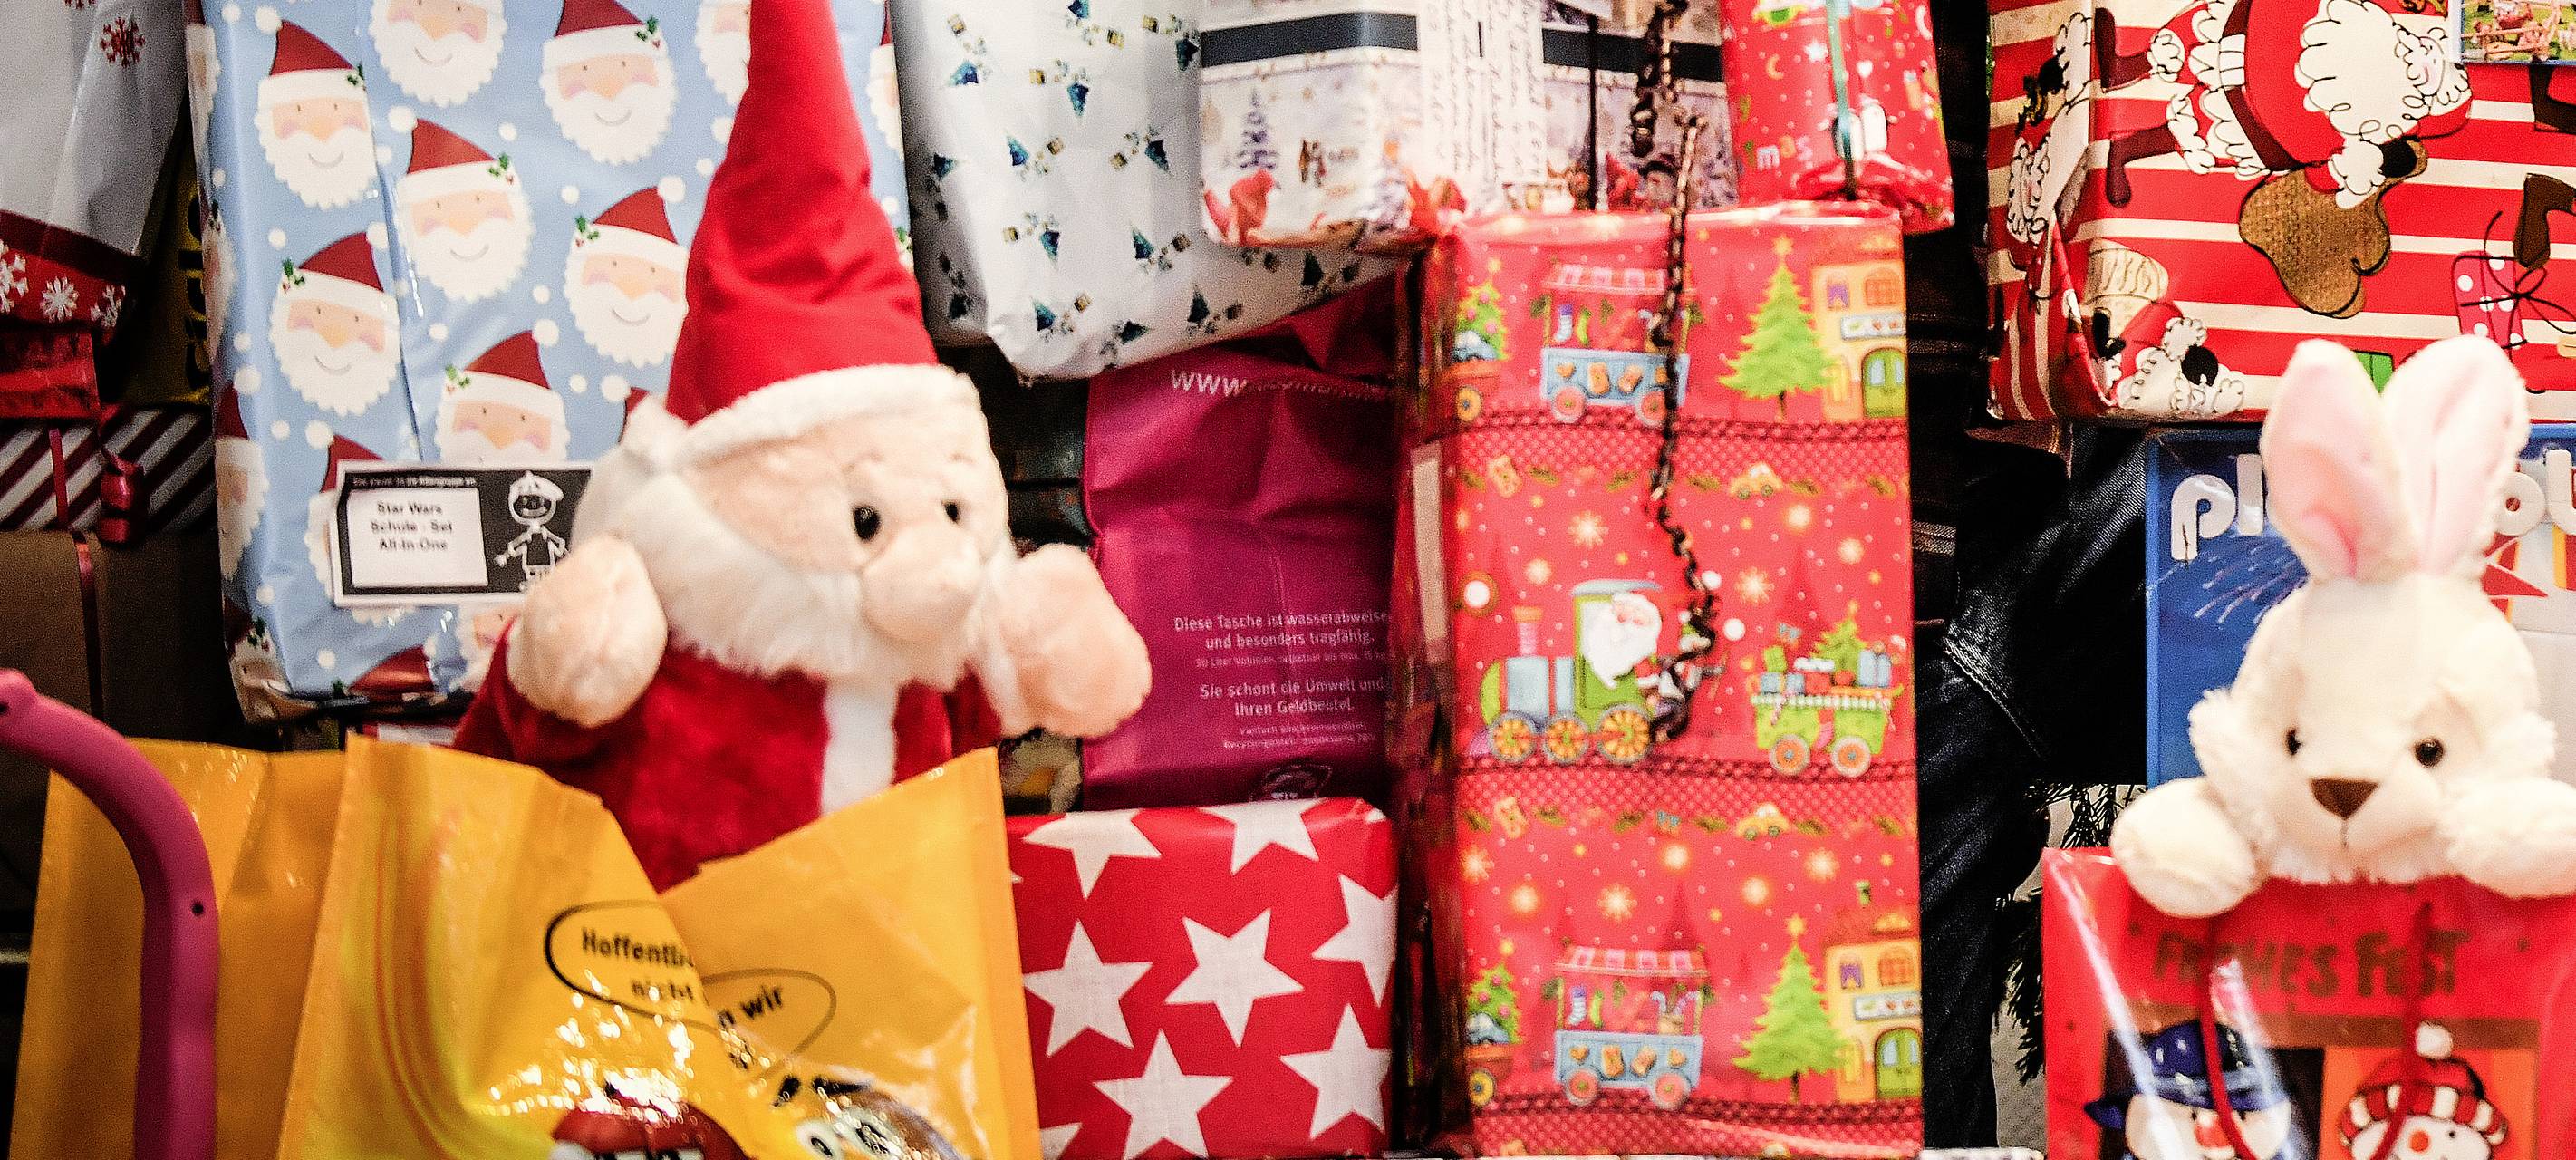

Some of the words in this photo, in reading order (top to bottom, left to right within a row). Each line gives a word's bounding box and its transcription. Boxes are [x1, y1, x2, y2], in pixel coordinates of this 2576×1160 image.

[377, 500, 404, 515] Star
[408, 500, 443, 515] Wars
[371, 520, 418, 534] Schule
[430, 519, 453, 534] Set
[1173, 615, 1213, 632] Diese
[1217, 614, 1262, 629] Tasche
[1267, 612, 1283, 627] ist
[1287, 609, 1389, 627] wasserabweise
[1205, 633, 1232, 651] und
[1236, 631, 1306, 649] besonders
[1309, 628, 1375, 647] tragfähig.
[1200, 683, 1223, 700] Sie
[1227, 682, 1277, 698] schont
[1280, 680, 1301, 695] die
[1305, 677, 1356, 694] Umwelt
[1359, 675, 1384, 691] und
[1234, 701, 1273, 717] Ihren
[740, 983, 785, 1020] wir
